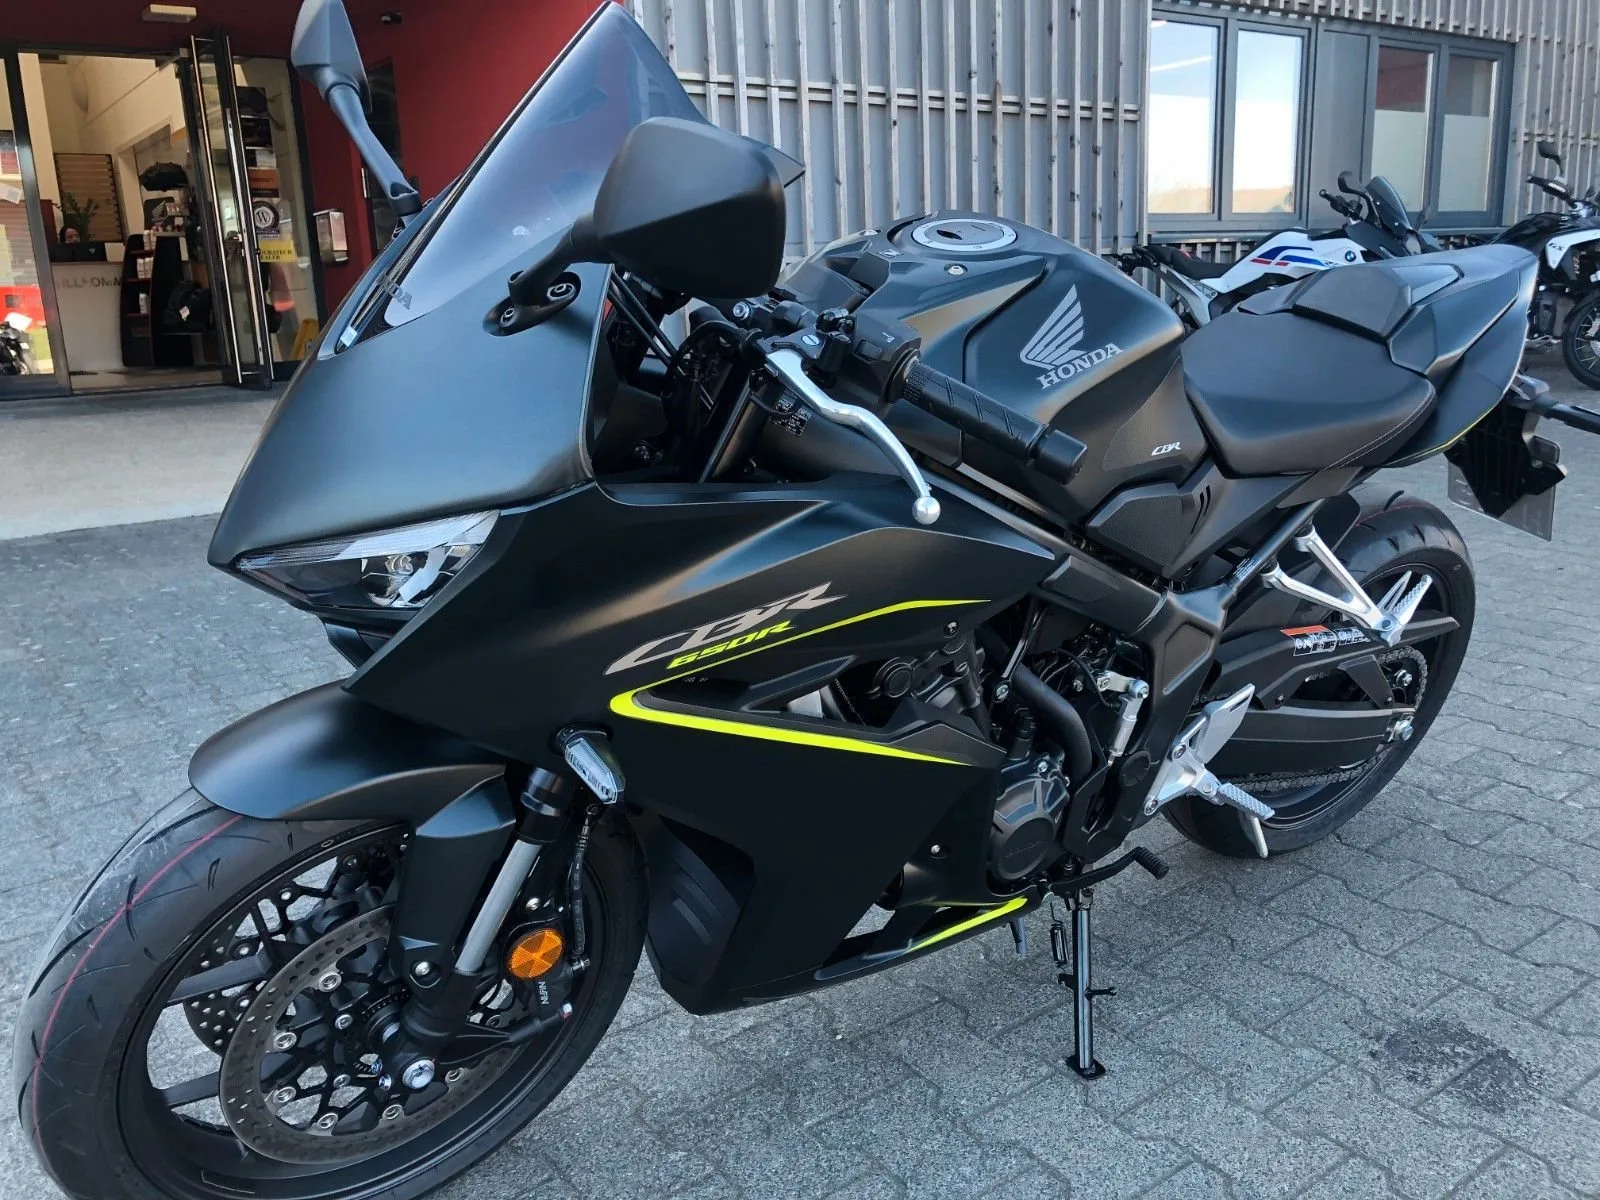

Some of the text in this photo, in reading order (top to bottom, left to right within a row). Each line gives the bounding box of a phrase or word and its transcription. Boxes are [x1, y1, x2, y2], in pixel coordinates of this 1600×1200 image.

[1036, 343, 1123, 389] HONDA
[1151, 441, 1181, 456] CBR
[604, 581, 847, 675] CBR
[666, 620, 794, 669] 650R
